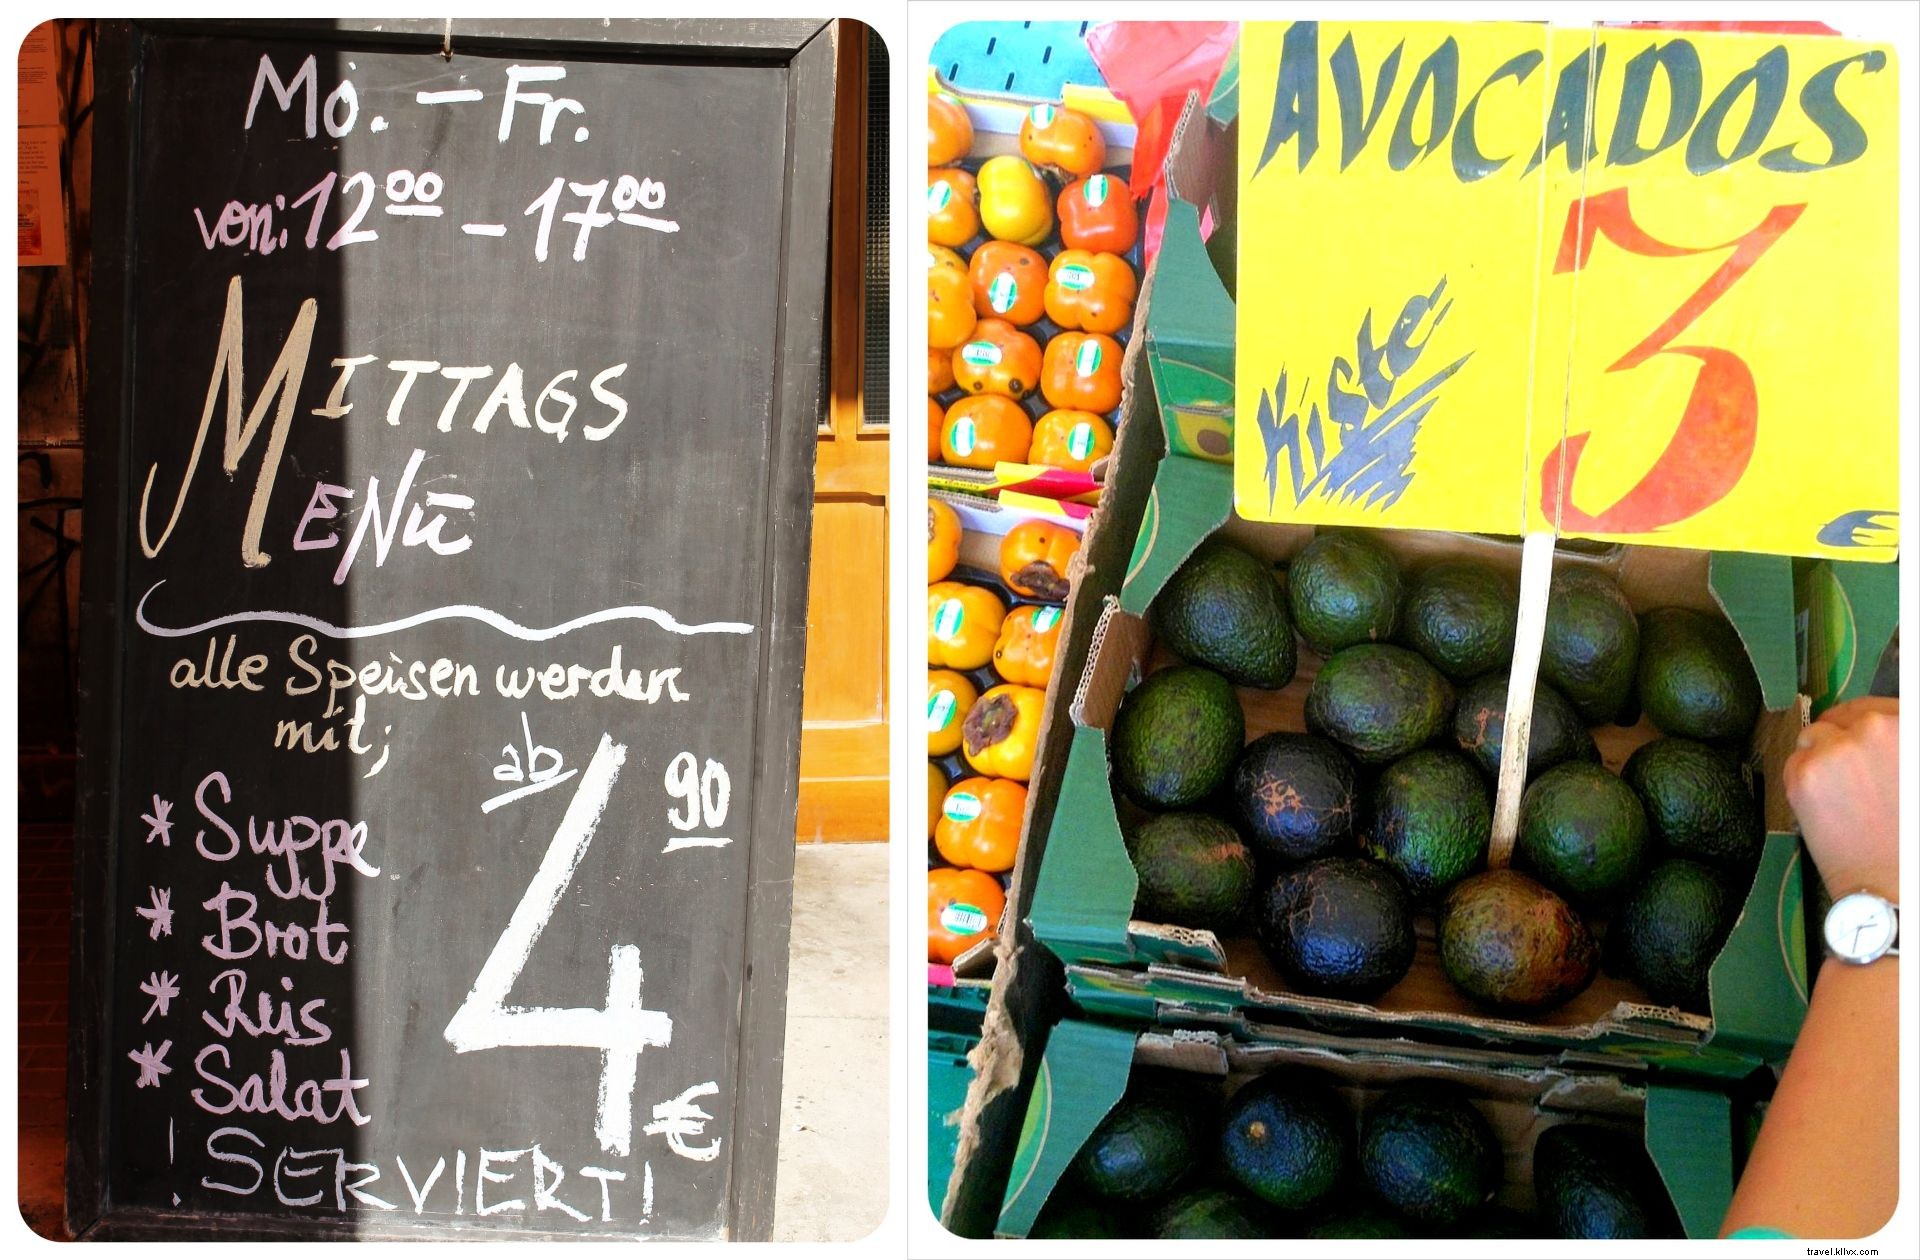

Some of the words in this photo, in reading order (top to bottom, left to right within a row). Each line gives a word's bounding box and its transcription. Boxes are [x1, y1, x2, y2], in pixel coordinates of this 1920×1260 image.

[245, 53, 388, 139] Mo.
[498, 65, 589, 146] Fr.
[1250, 21, 1887, 183] AVOCADOS
[194, 194, 288, 255] von:
[1540, 186, 1808, 533] 3
[170, 635, 269, 692] alle
[285, 634, 482, 718] Speisen
[491, 710, 570, 790] ab
[663, 751, 732, 832] 90
[194, 770, 381, 900] Suppe
[201, 880, 350, 966] Brot
[443, 731, 674, 1157] 4
[202, 968, 332, 1046] Reis
[190, 1043, 372, 1127] Salat
[642, 1080, 722, 1162] €
